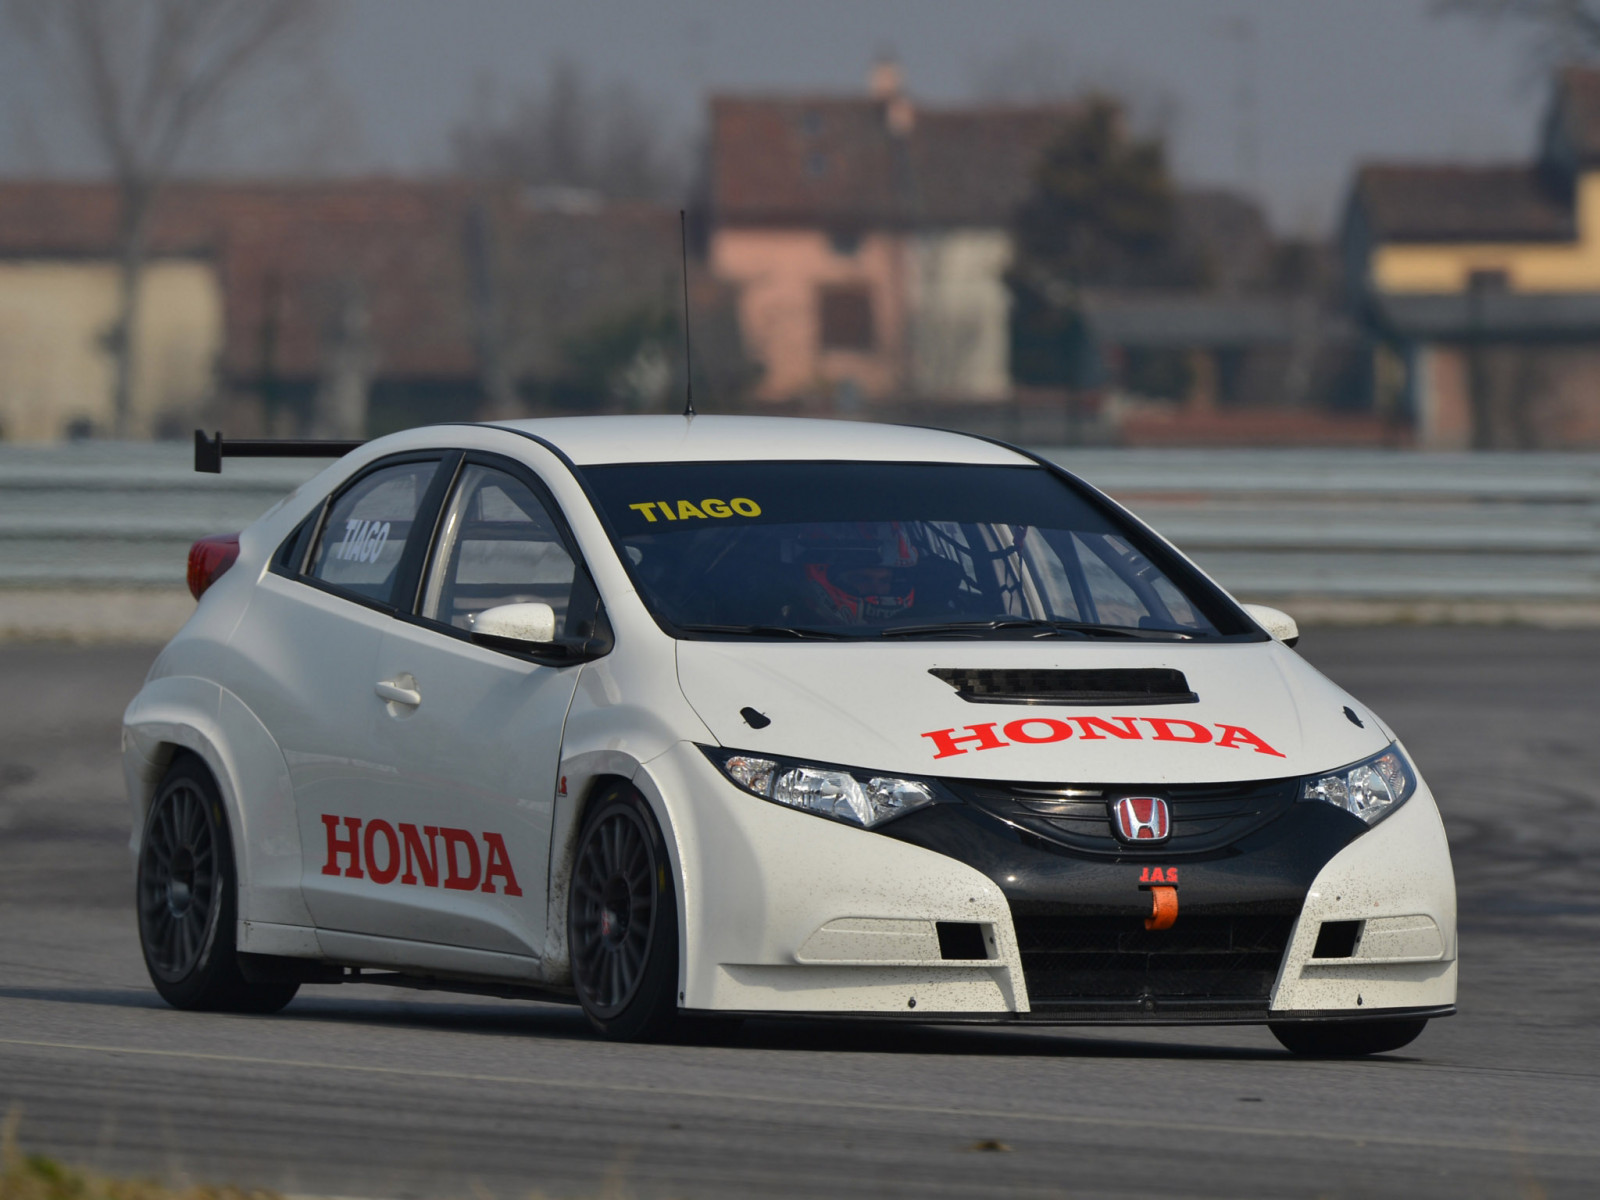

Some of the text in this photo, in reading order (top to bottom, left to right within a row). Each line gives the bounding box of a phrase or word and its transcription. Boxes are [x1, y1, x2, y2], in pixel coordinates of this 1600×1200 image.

[629, 497, 762, 522] TIAGO
[337, 519, 391, 564] TIAGO
[921, 716, 1286, 759] HONDA
[321, 814, 522, 897] HONDA
[1139, 866, 1179, 882] JAS
